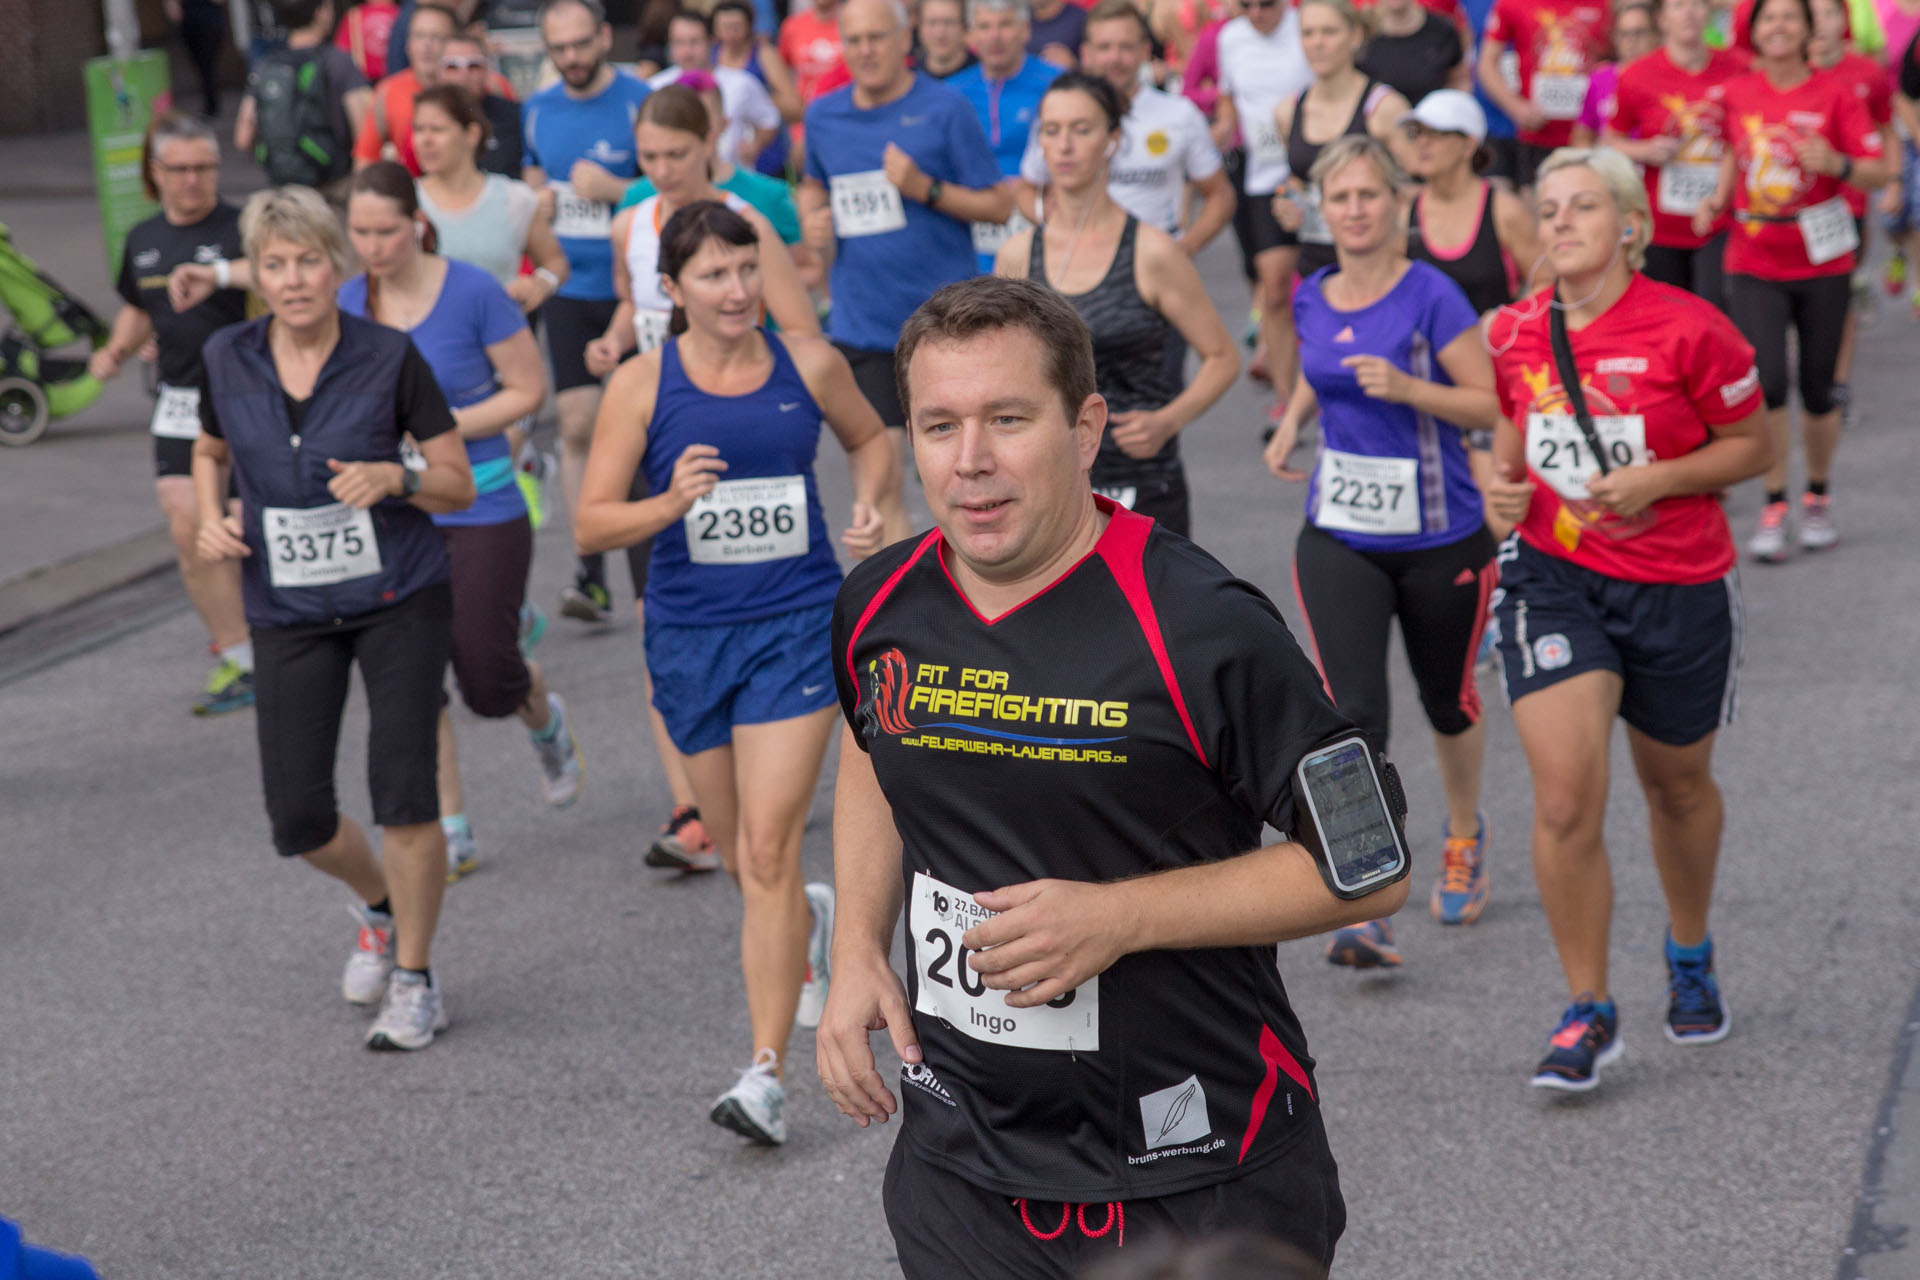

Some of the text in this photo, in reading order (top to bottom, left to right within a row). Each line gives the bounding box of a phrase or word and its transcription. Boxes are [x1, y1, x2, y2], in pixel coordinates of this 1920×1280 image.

[841, 189, 891, 216] 1591
[1538, 440, 1633, 469] 210
[1330, 476, 1404, 511] 2237
[698, 503, 794, 540] 2386
[277, 526, 364, 563] 3375
[916, 663, 1009, 691] FIT FOR
[909, 685, 1129, 728] FIREFIGHTING
[925, 928, 1077, 1009] 20
[970, 1006, 1016, 1035] Ingo
[1128, 1138, 1226, 1165] bruns-werbung.de
